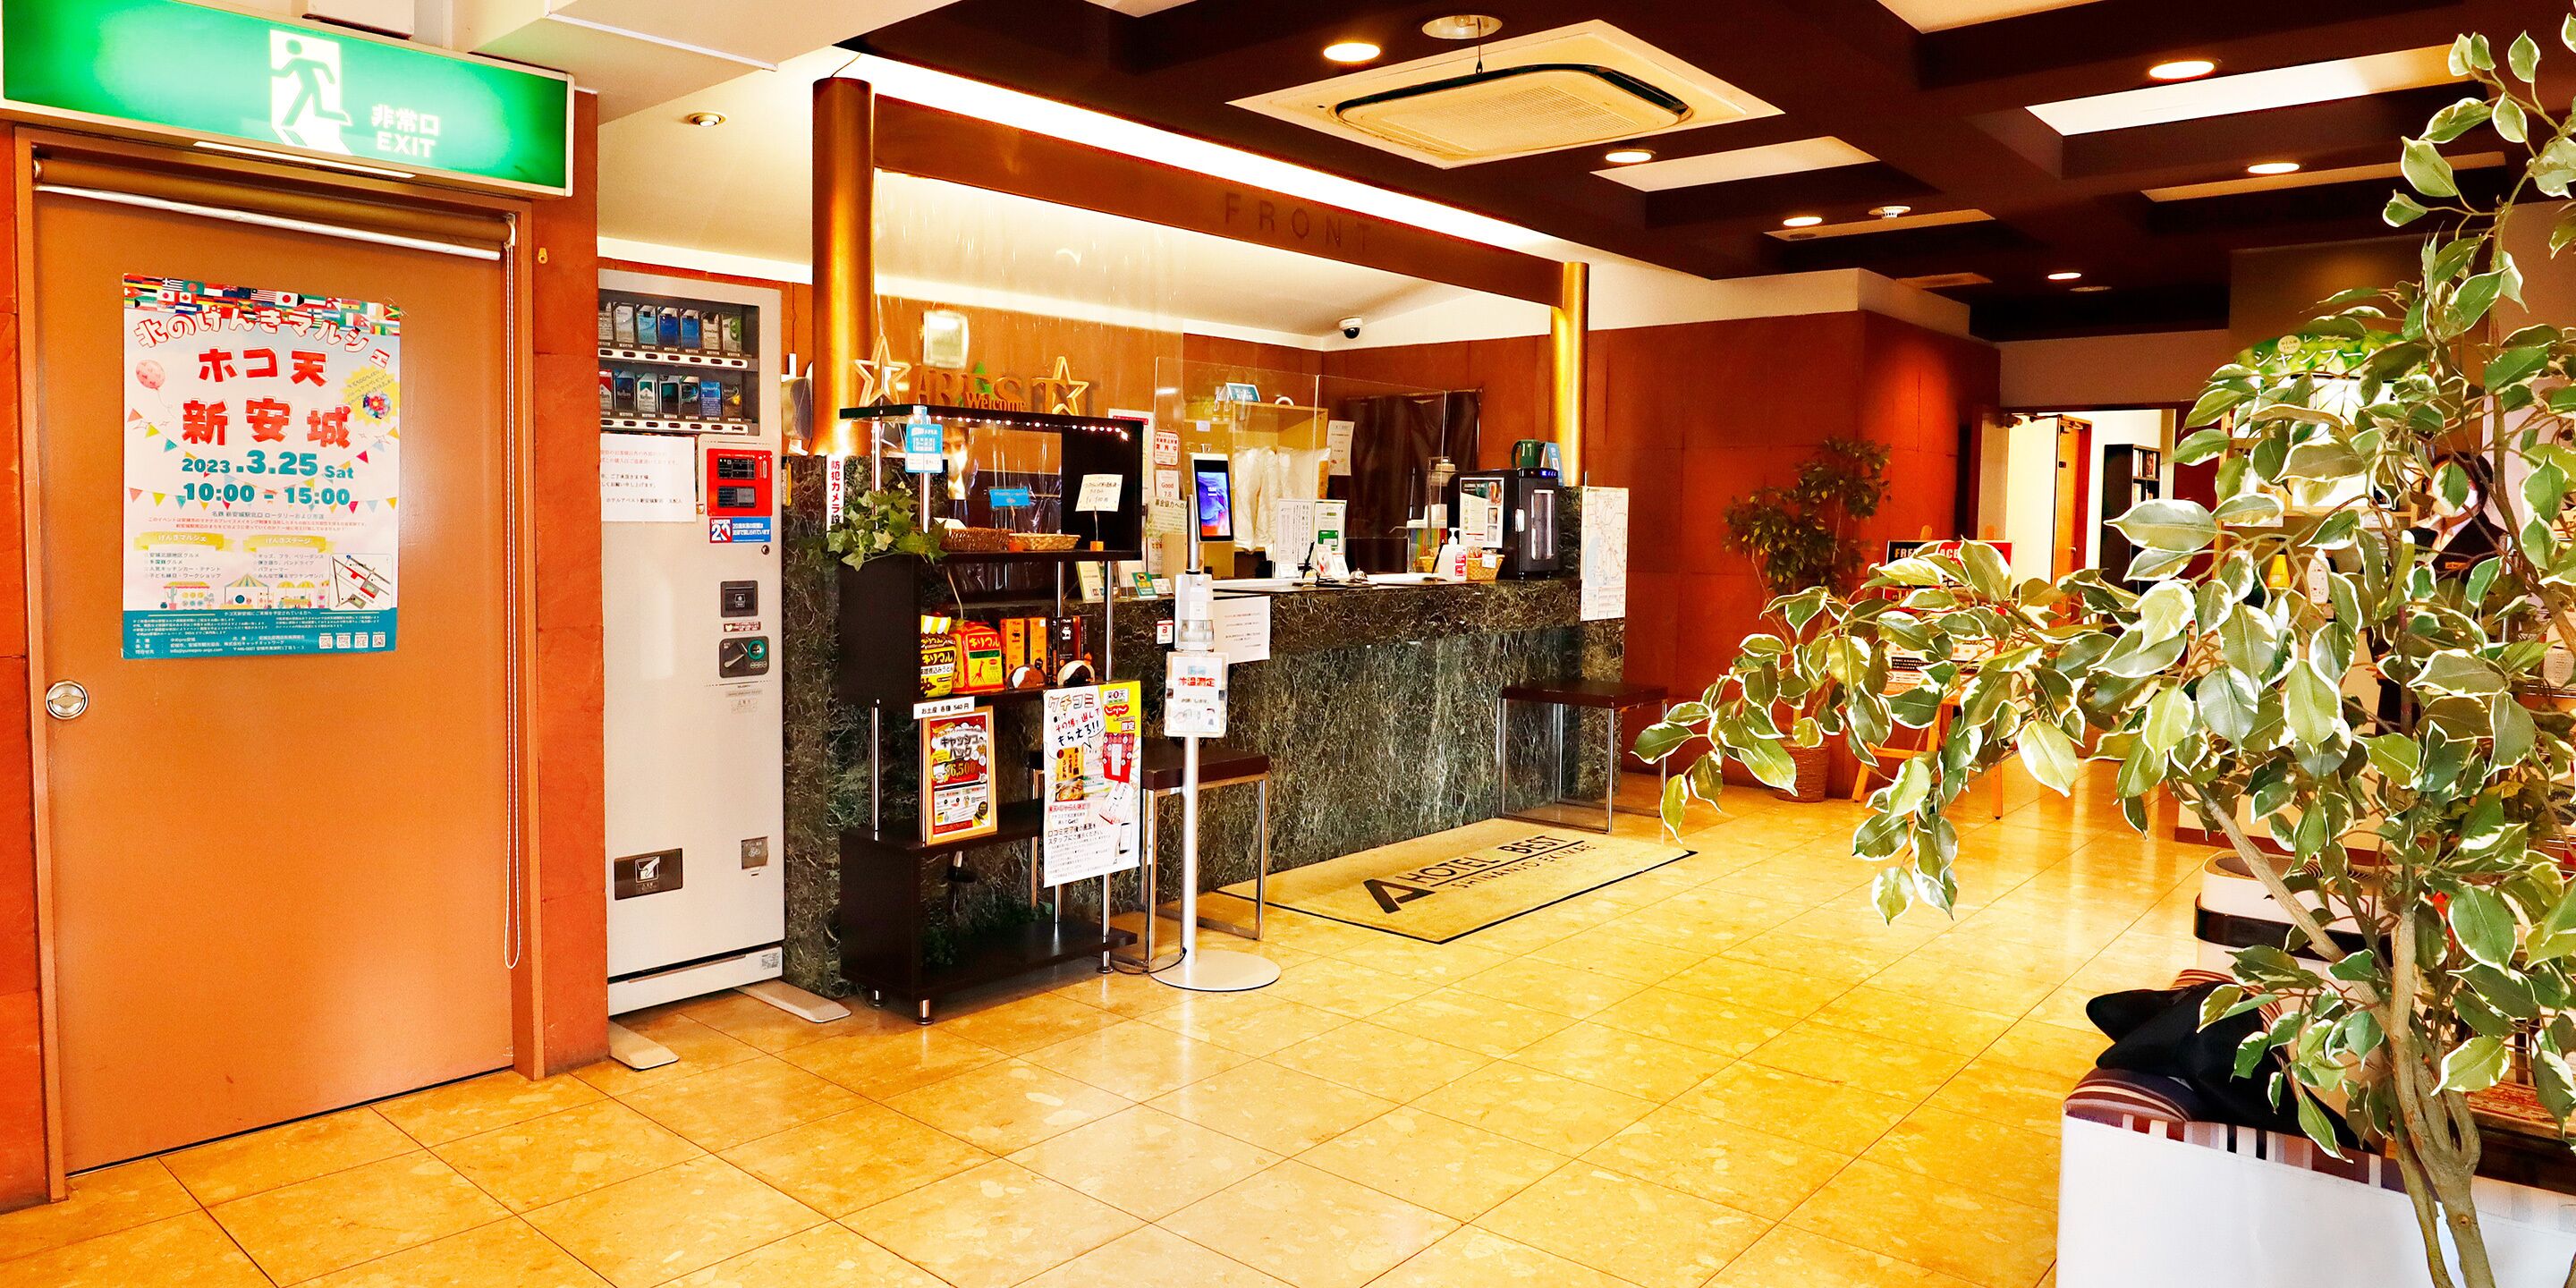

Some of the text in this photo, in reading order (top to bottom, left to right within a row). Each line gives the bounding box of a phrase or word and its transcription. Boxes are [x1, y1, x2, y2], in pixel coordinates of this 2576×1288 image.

[372, 104, 439, 136] 非常口
[377, 131, 436, 157] EXIT
[1224, 191, 1371, 255] FRONT
[198, 347, 330, 387] ホコ天
[965, 391, 1026, 412] Welcome
[181, 395, 353, 449] 新安城
[324, 464, 355, 479] Sat
[182, 482, 256, 504] 10:00
[284, 487, 351, 507] 15:00
[1396, 835, 1568, 884] HOTEL BEST
